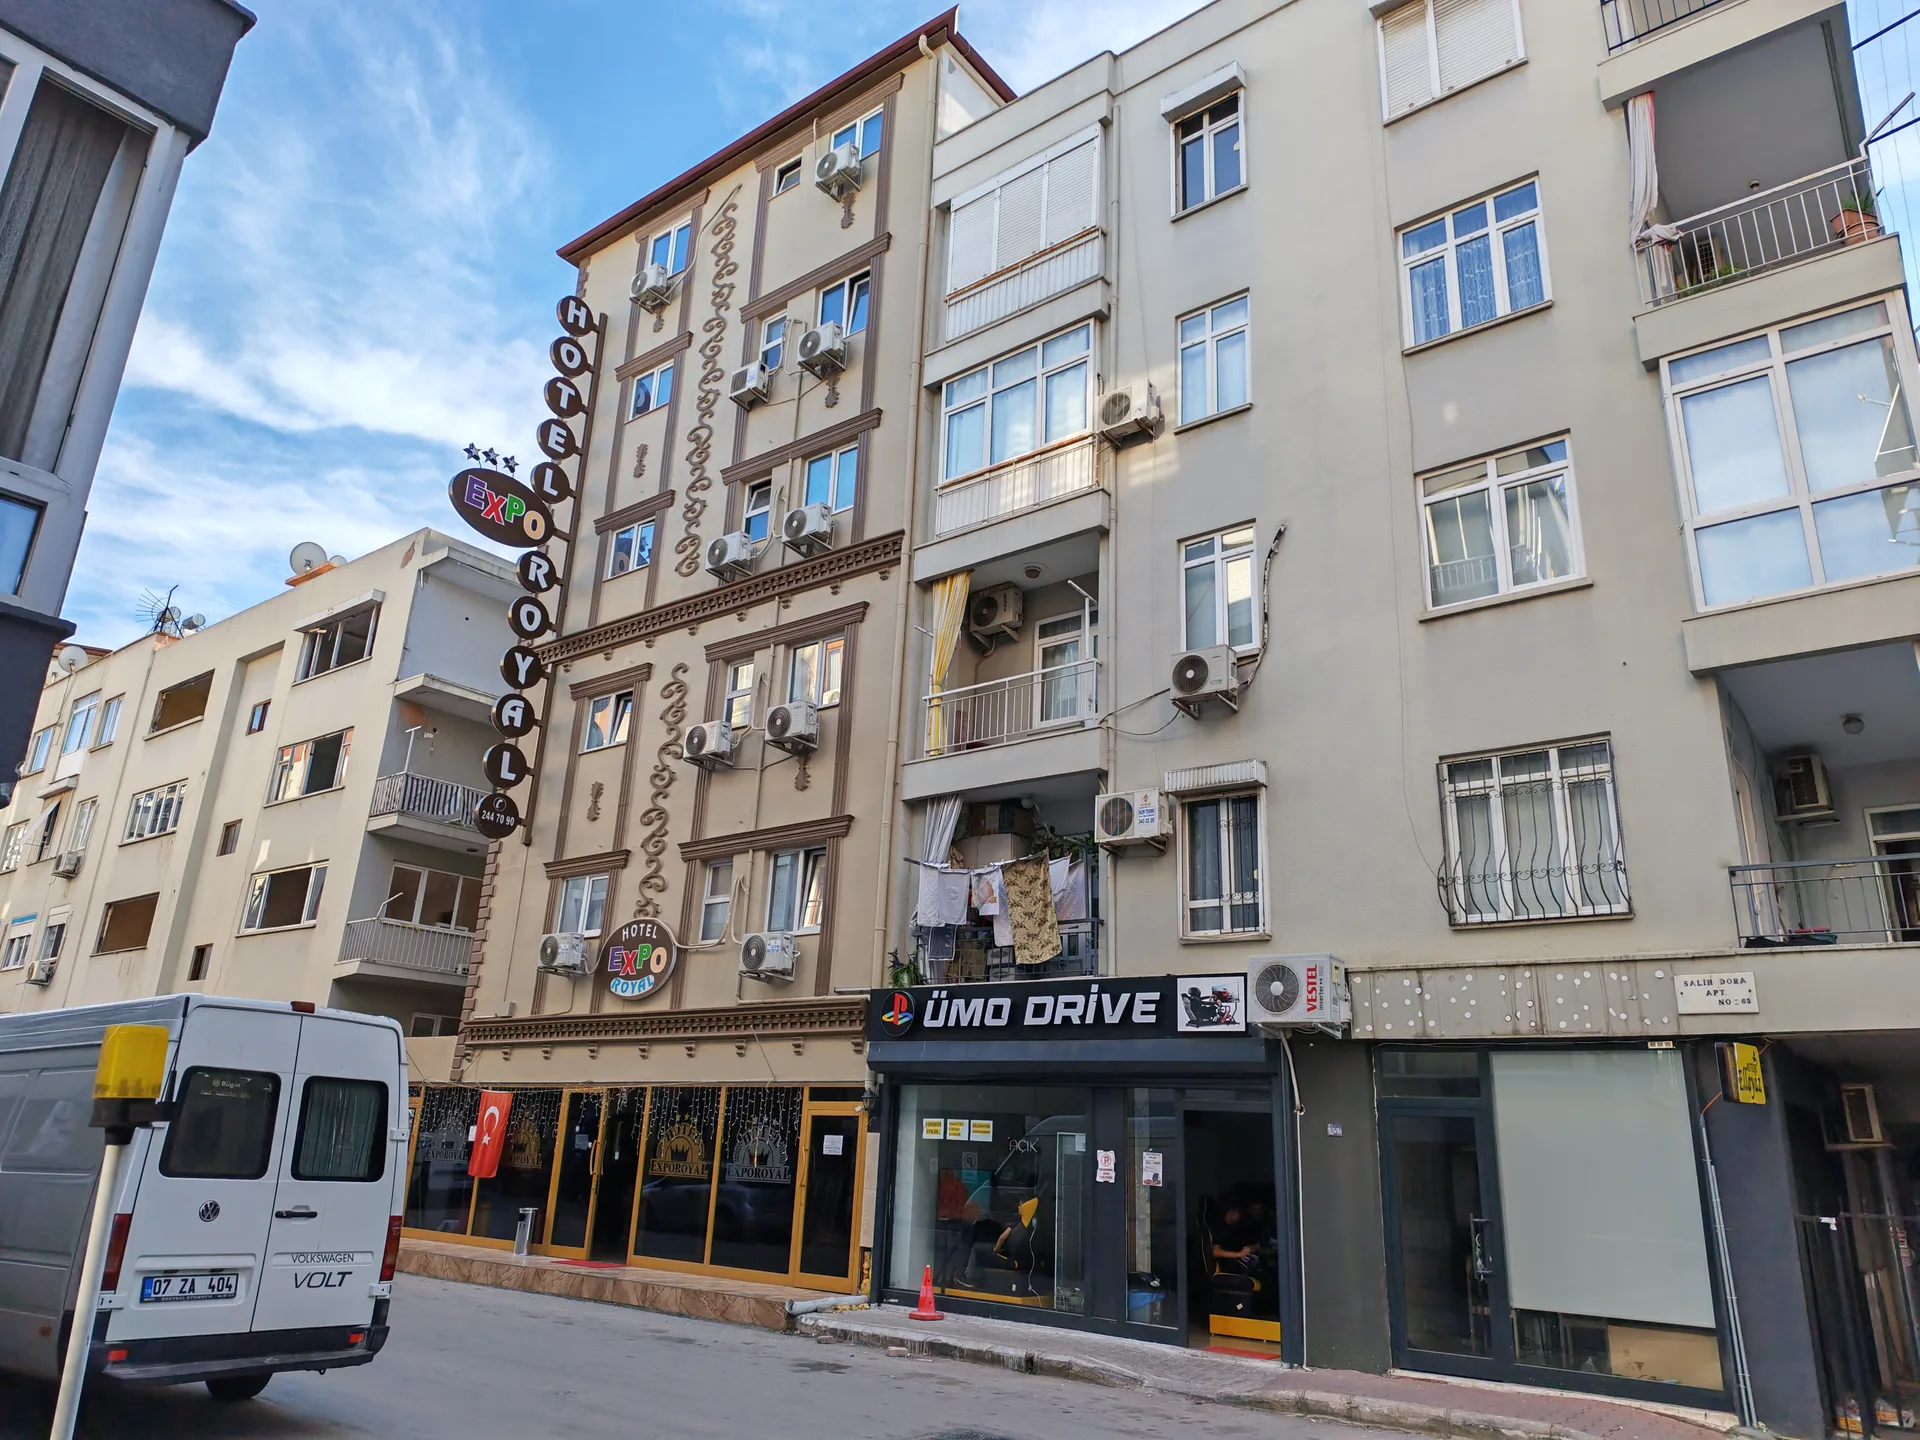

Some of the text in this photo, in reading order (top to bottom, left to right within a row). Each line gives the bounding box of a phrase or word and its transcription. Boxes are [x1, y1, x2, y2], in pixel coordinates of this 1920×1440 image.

[543, 299, 587, 496] HOTEL
[464, 474, 545, 540] EXPO
[500, 555, 549, 781] ROYAL
[481, 810, 515, 827] 244 70 90
[622, 923, 658, 942] HOTEL
[608, 943, 668, 976] EXPO
[611, 976, 655, 995] ROYAL
[1306, 964, 1317, 1012] VESTEL
[1719, 977, 1747, 985] DORA
[1706, 989, 1727, 997] APT.
[1718, 998, 1732, 1006] NO
[923, 984, 1161, 1028] ÜMO DRİVE
[1009, 1139, 1039, 1153] AÇIK
[650, 1161, 707, 1176] EXPOROYAL
[727, 1165, 791, 1180] EXPOROYAL
[291, 1253, 354, 1263] VOLKSWAGEN
[152, 1276, 233, 1295] 07 ZA 404
[294, 1271, 353, 1288] VOLT
